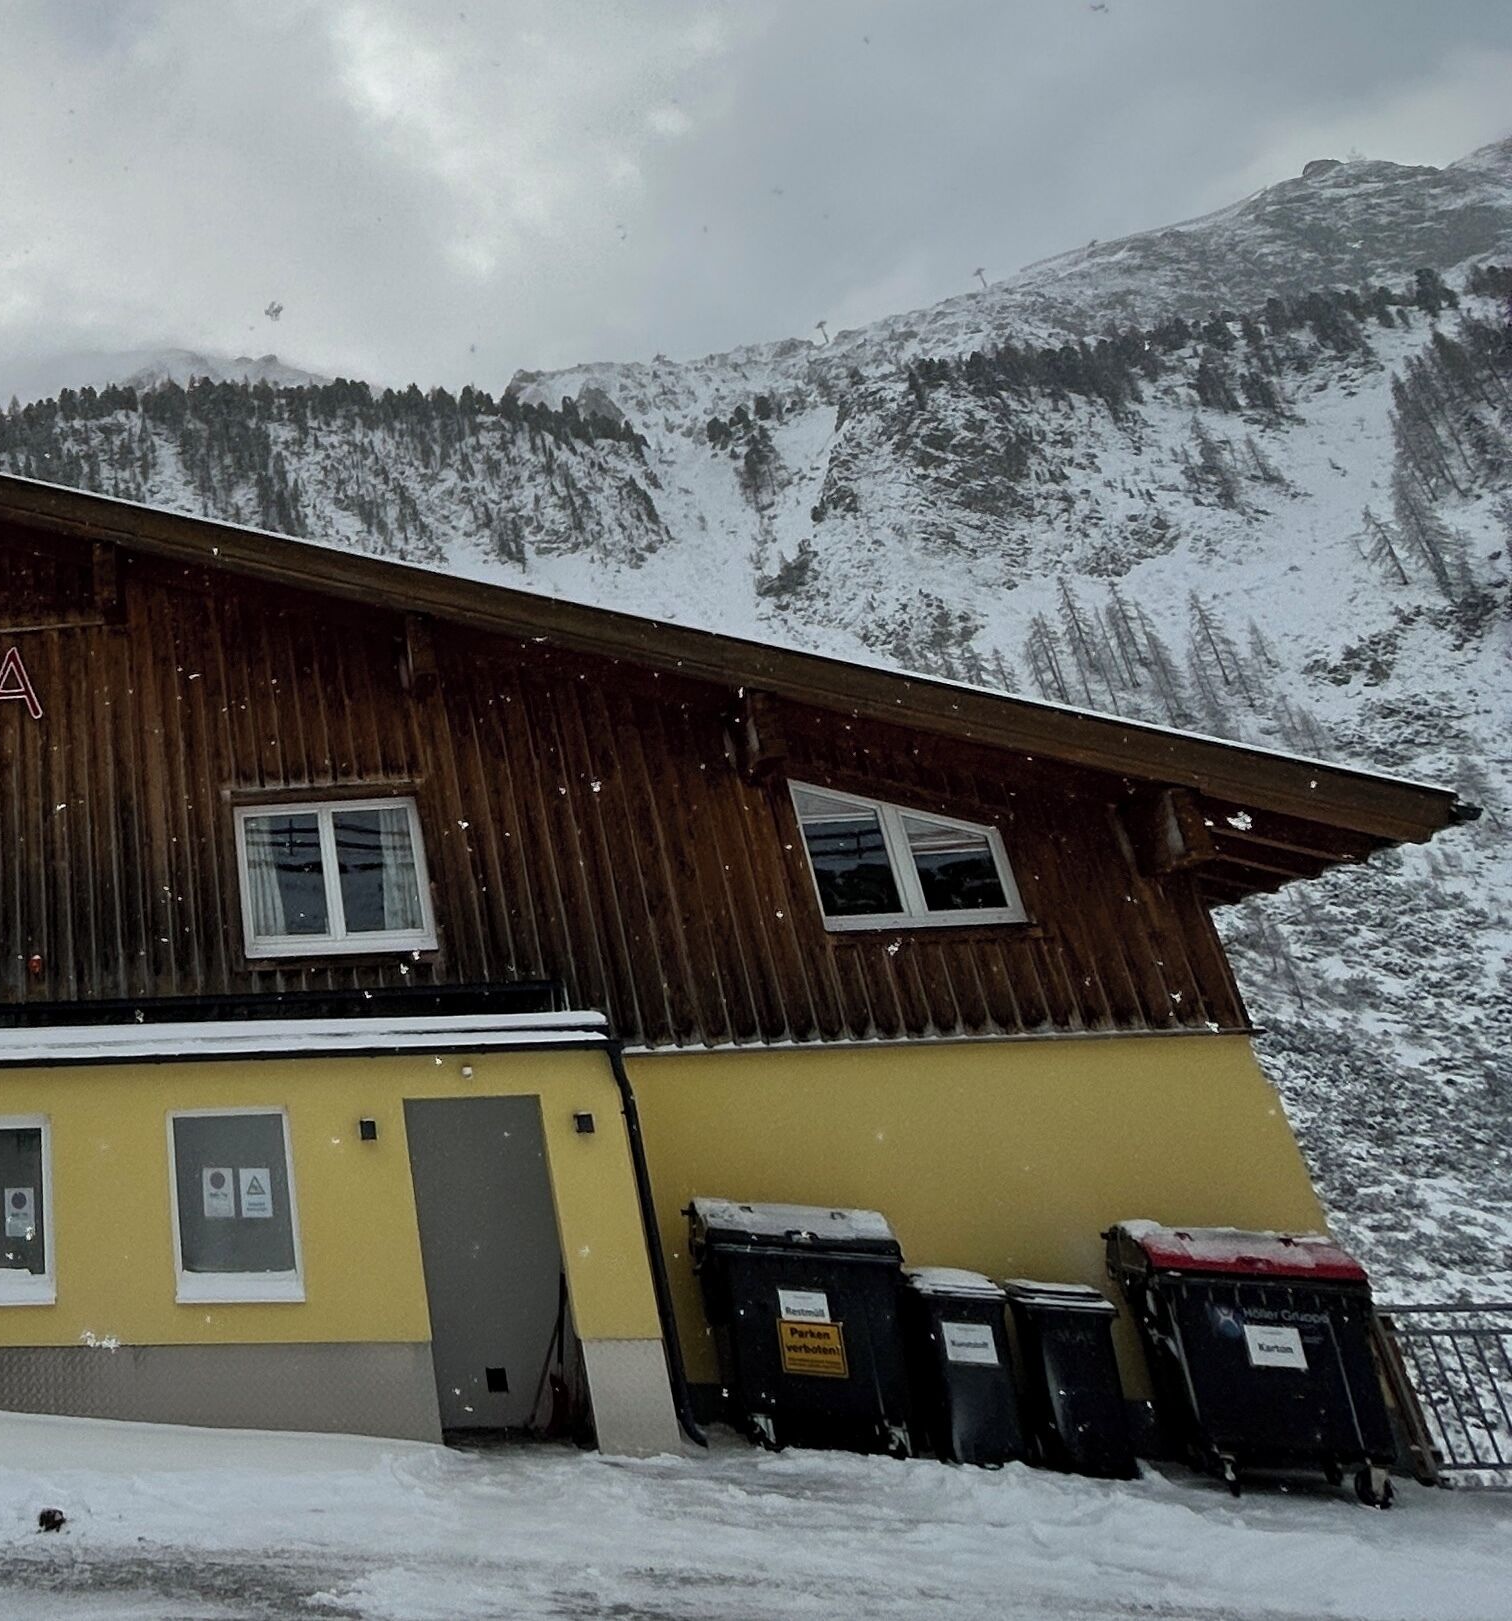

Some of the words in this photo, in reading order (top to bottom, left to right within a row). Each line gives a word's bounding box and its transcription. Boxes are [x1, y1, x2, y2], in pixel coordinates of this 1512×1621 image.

[785, 1306, 826, 1318] Restmüll
[789, 1327, 831, 1340] Parken
[786, 1344, 841, 1356] verboten!
